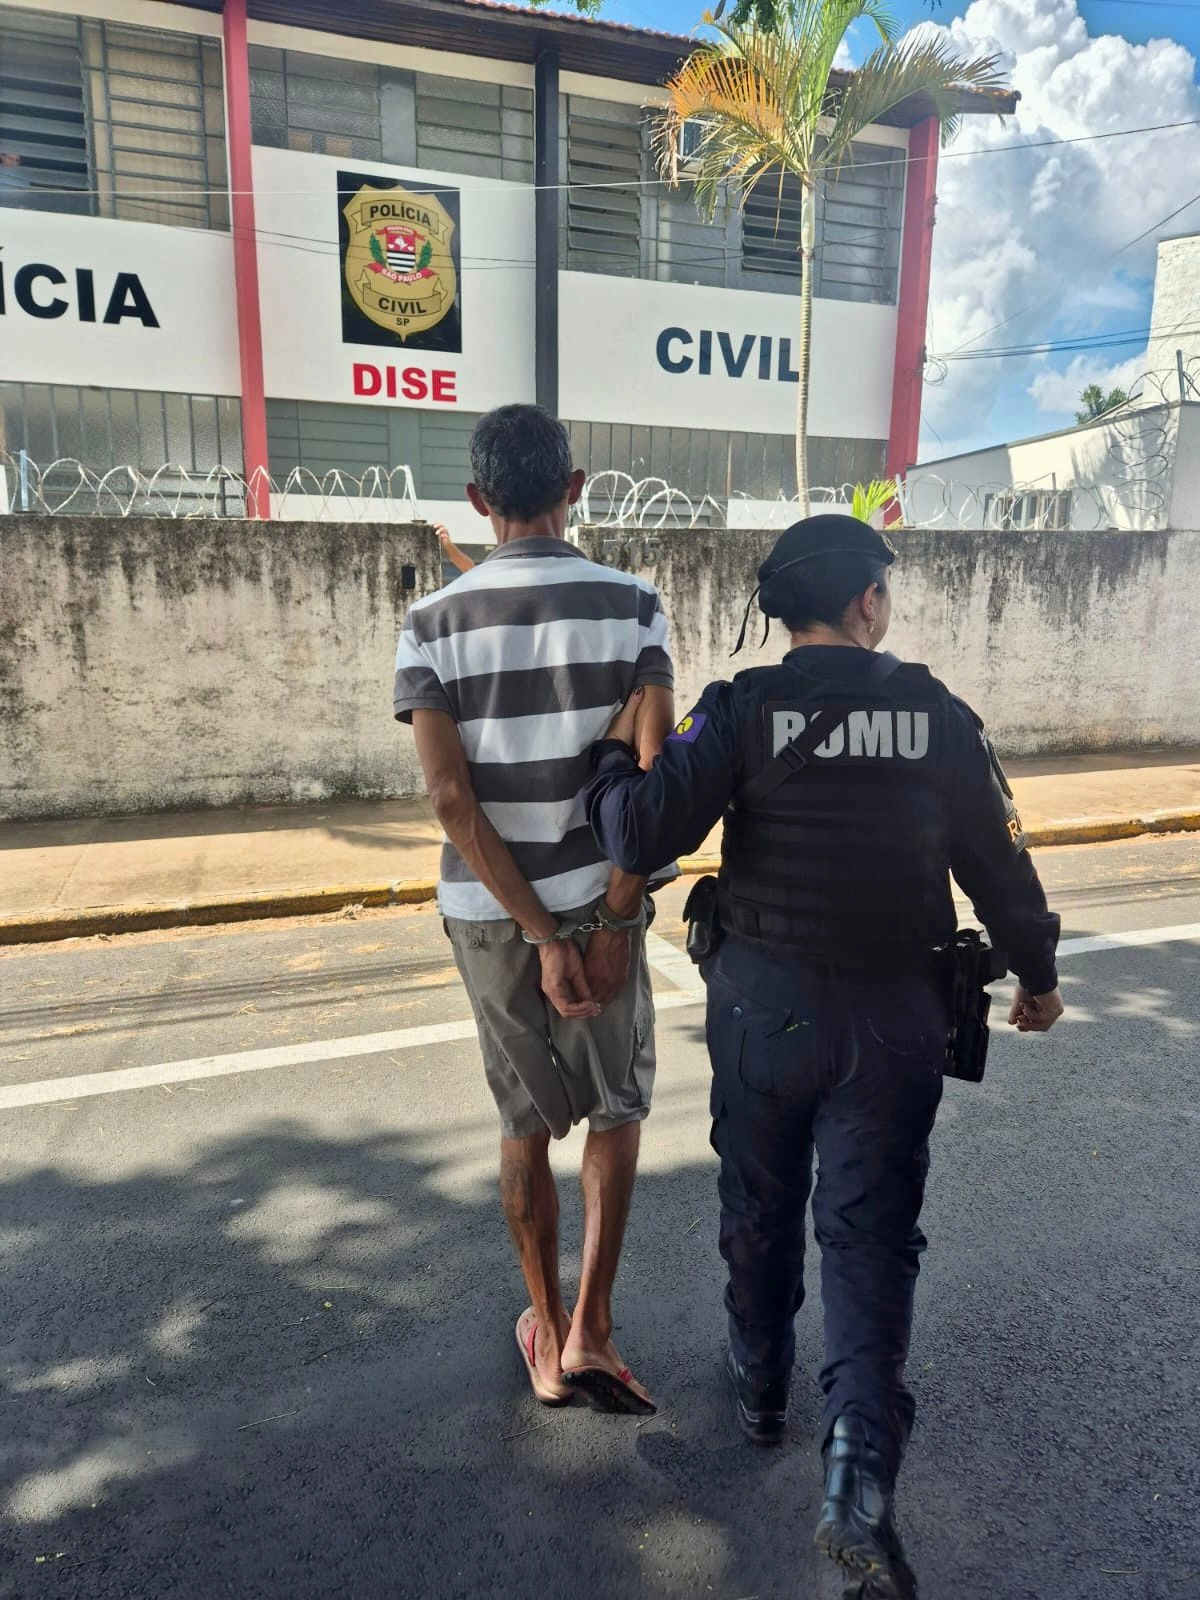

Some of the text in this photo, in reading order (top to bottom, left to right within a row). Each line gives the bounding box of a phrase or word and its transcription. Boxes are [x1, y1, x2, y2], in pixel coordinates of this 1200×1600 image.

[370, 201, 431, 227] POLÍCIA
[398, 272, 422, 282] PAULO
[378, 297, 427, 314] CIVIL
[396, 317, 410, 326] SP
[656, 327, 799, 382] CIVIL
[353, 363, 457, 402] DISE
[601, 537, 664, 567] 515
